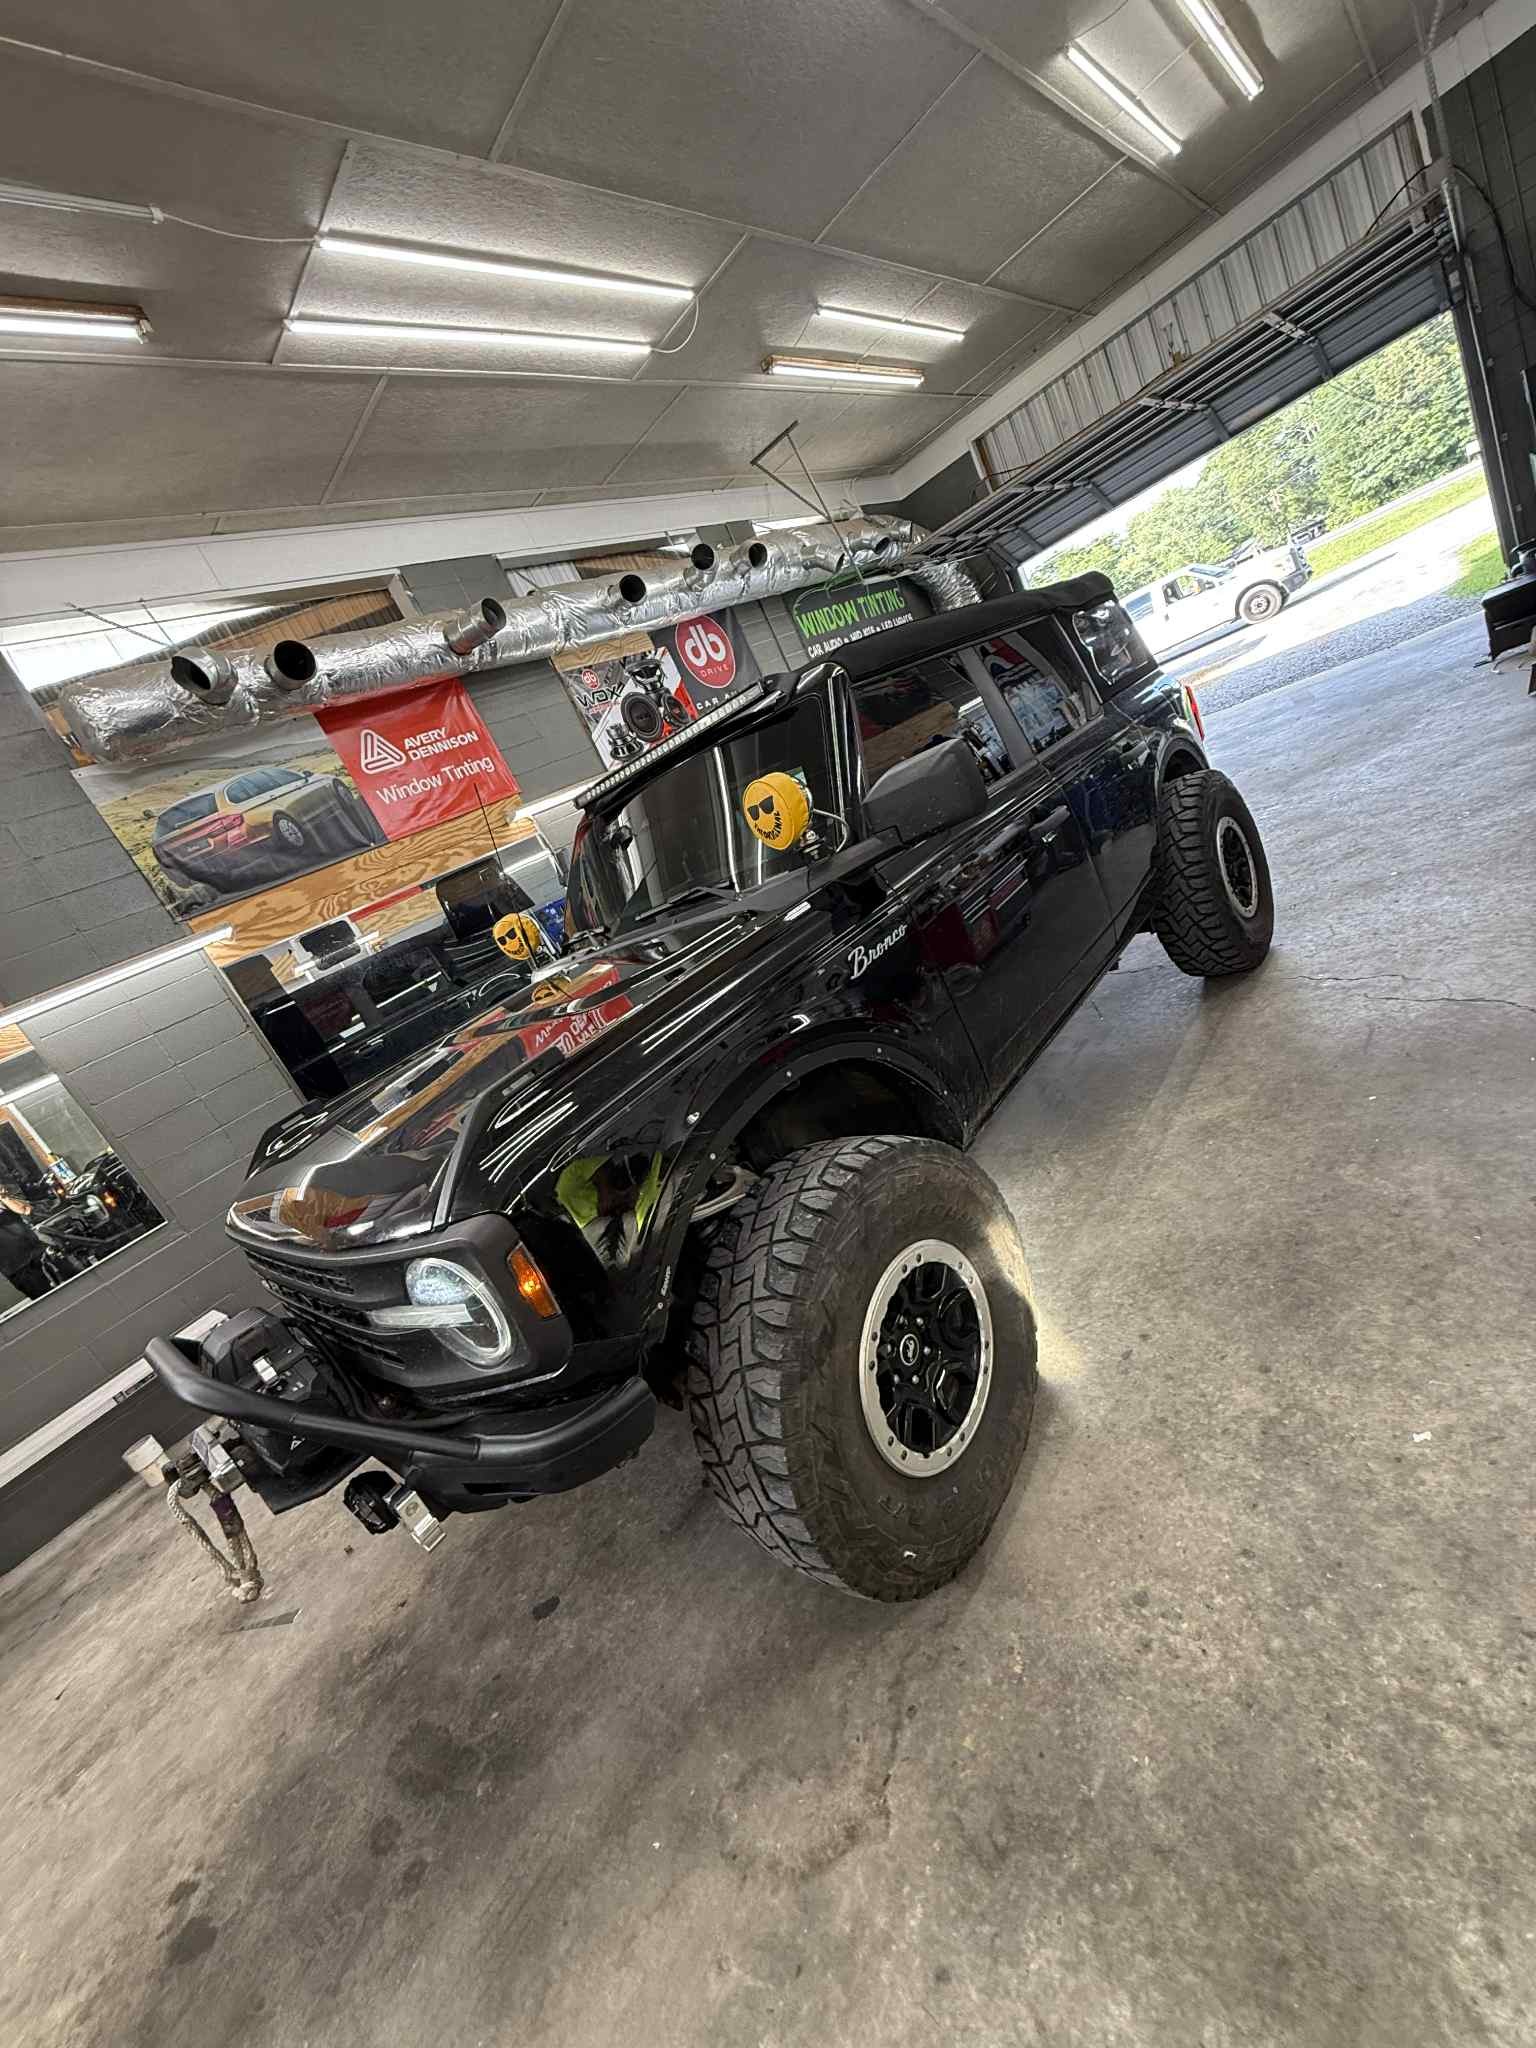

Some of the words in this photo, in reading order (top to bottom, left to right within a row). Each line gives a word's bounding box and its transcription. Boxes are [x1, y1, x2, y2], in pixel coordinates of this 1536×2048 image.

[796, 600, 860, 639] WINDOW
[857, 588, 905, 618] TINTING
[685, 624, 726, 667] db
[807, 642, 825, 658] CAR
[700, 663, 729, 678] DRIVE
[696, 697, 719, 710] CAR
[404, 727, 448, 750] AVERY
[408, 731, 479, 761] DENNISON
[376, 774, 443, 804] Window
[441, 756, 495, 783] Tinting
[848, 924, 908, 980] Bronco
